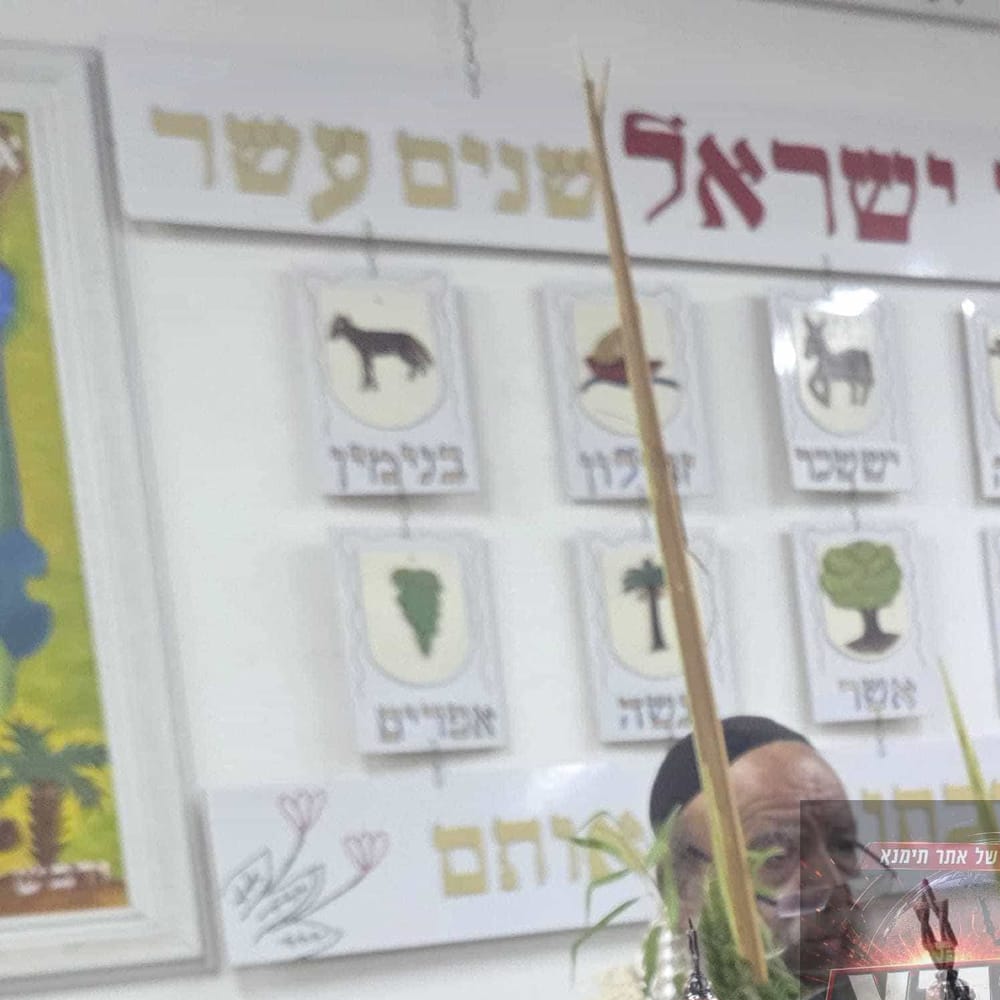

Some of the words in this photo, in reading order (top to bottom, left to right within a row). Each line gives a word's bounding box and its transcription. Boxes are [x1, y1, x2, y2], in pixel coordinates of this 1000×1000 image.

[150, 104, 370, 223] עשר
[395, 128, 600, 221] שנים
[622, 108, 957, 244] ישראל
[329, 441, 467, 490] בנימין
[375, 702, 497, 744] אפרים
[837, 676, 918, 712] אשר
